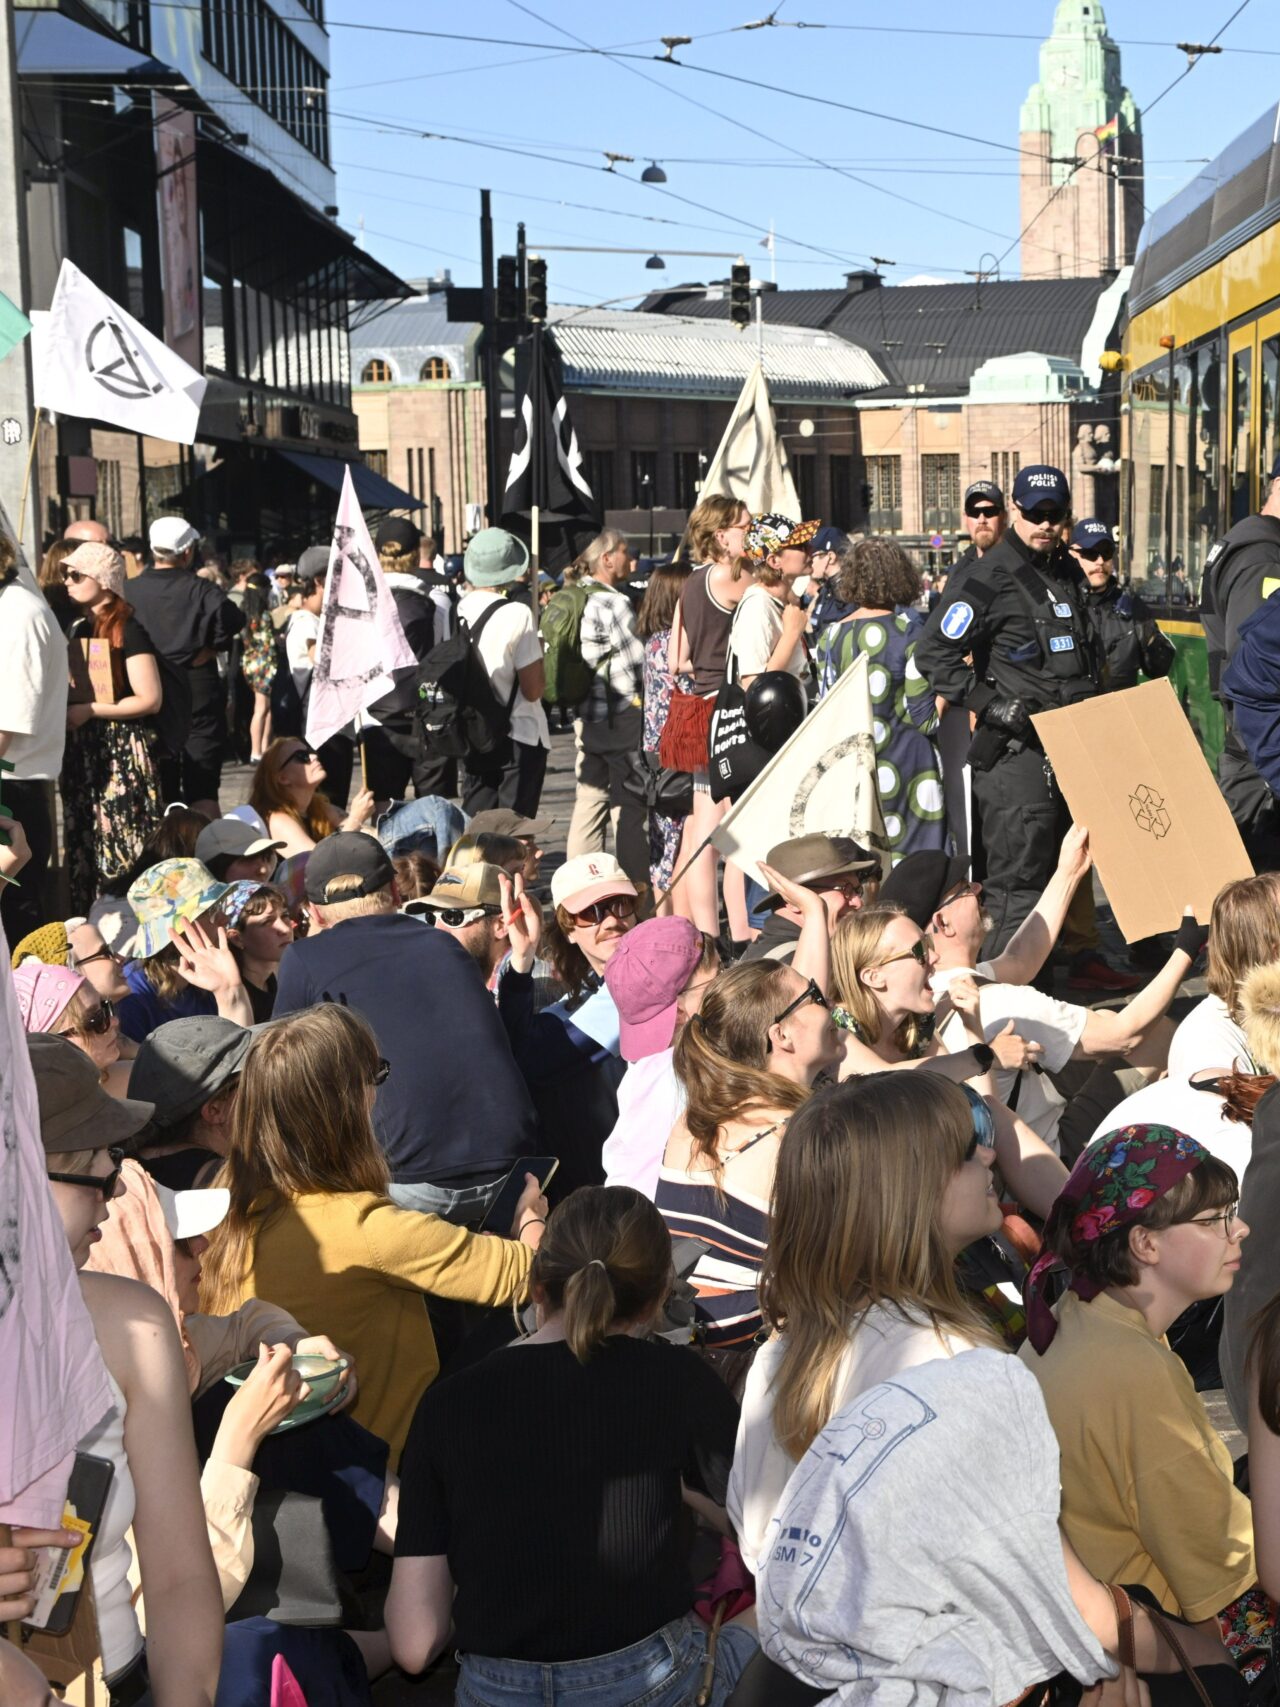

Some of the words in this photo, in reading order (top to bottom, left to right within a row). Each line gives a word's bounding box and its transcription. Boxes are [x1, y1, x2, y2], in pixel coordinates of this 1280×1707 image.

[1028, 473, 1058, 482] POLIISI
[1031, 480, 1056, 488] POLIS
[1054, 638, 1071, 650] 331
